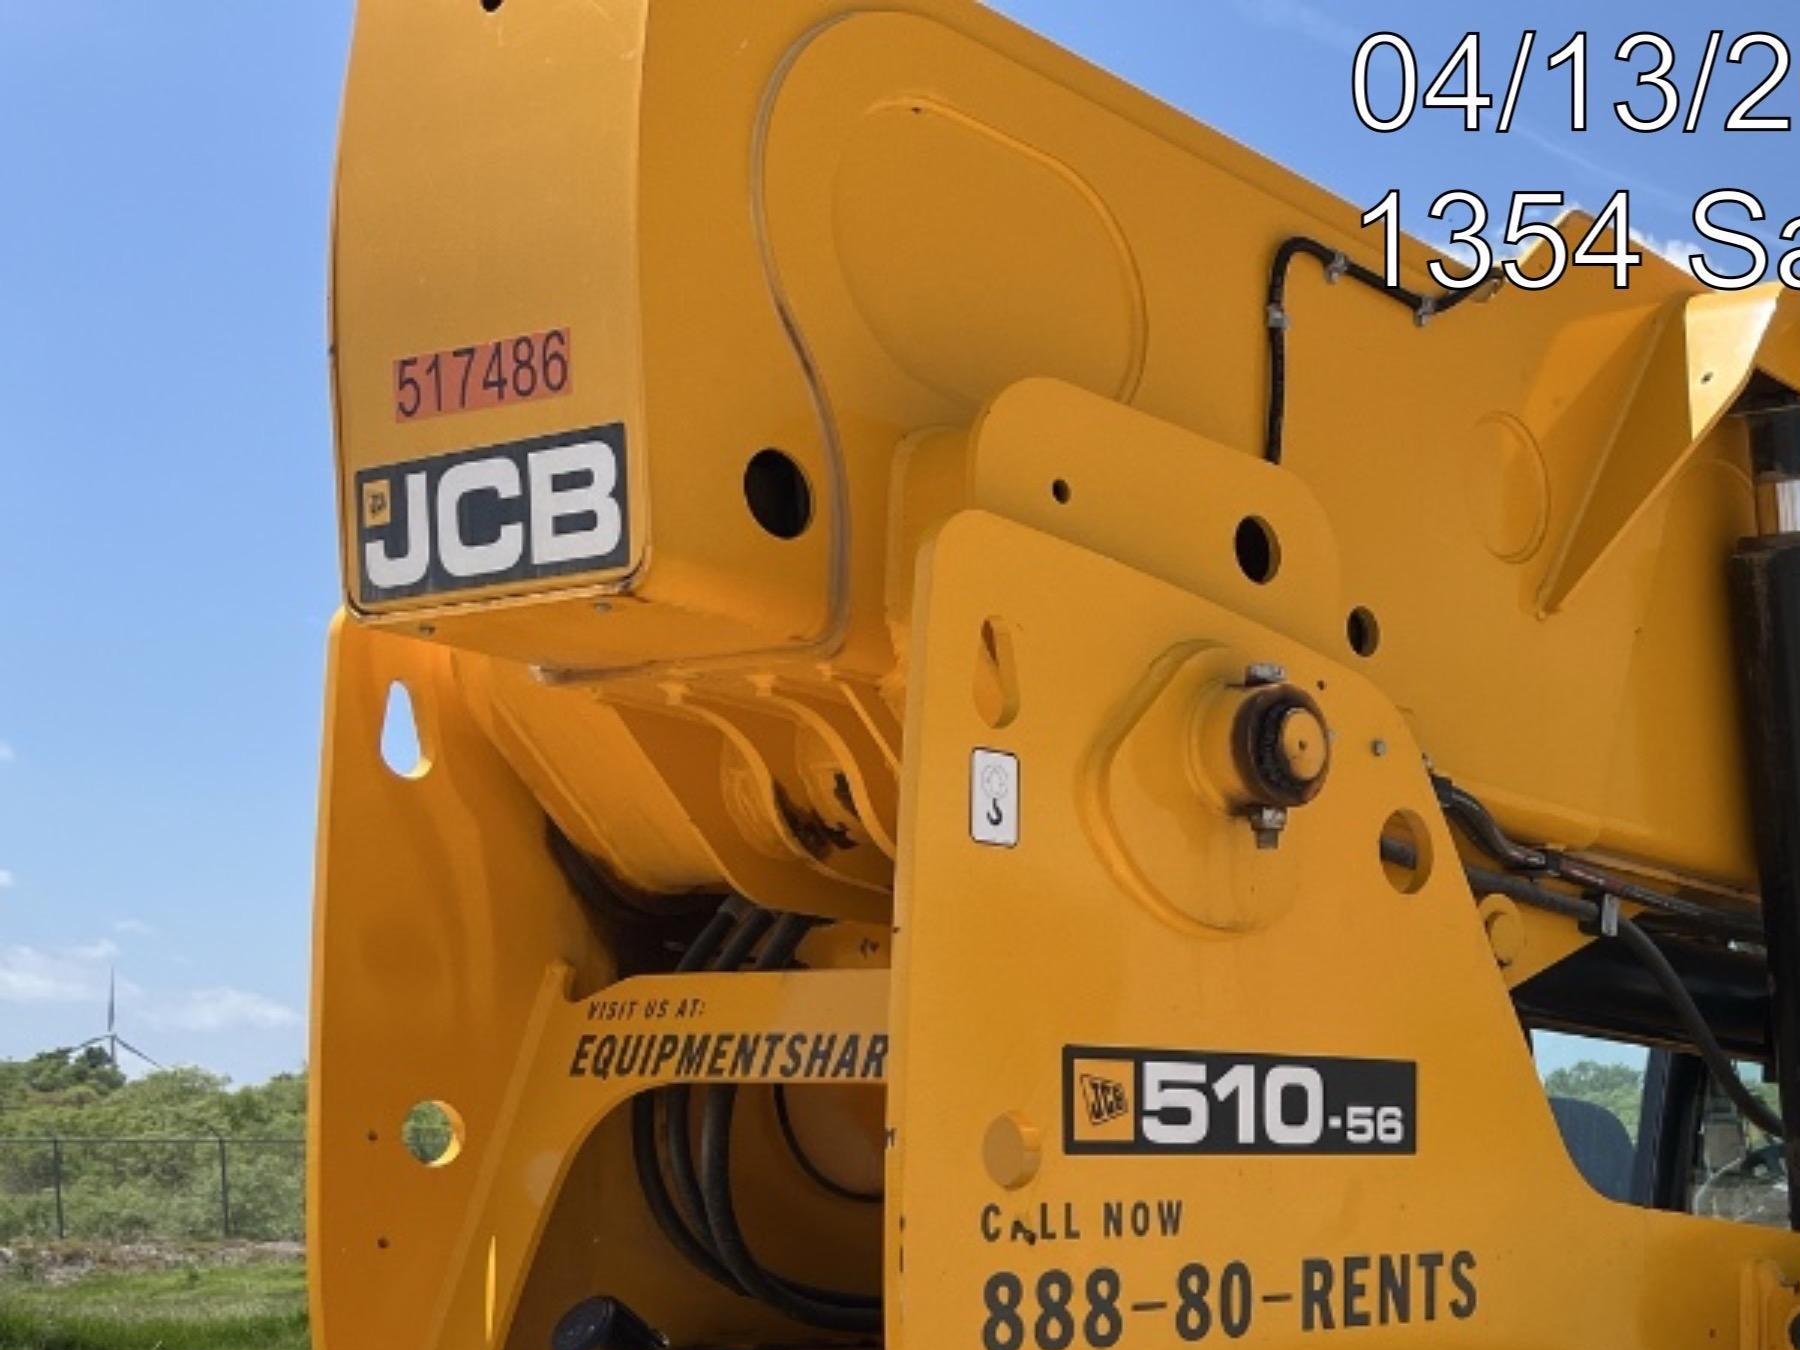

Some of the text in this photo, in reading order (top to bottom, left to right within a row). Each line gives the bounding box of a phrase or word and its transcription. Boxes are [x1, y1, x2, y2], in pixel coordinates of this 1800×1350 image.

[396, 329, 569, 418] 517486
[364, 439, 623, 589] JCB
[587, 1000, 638, 1021] VISIT
[980, 1200, 1183, 1245] CALL NOW
